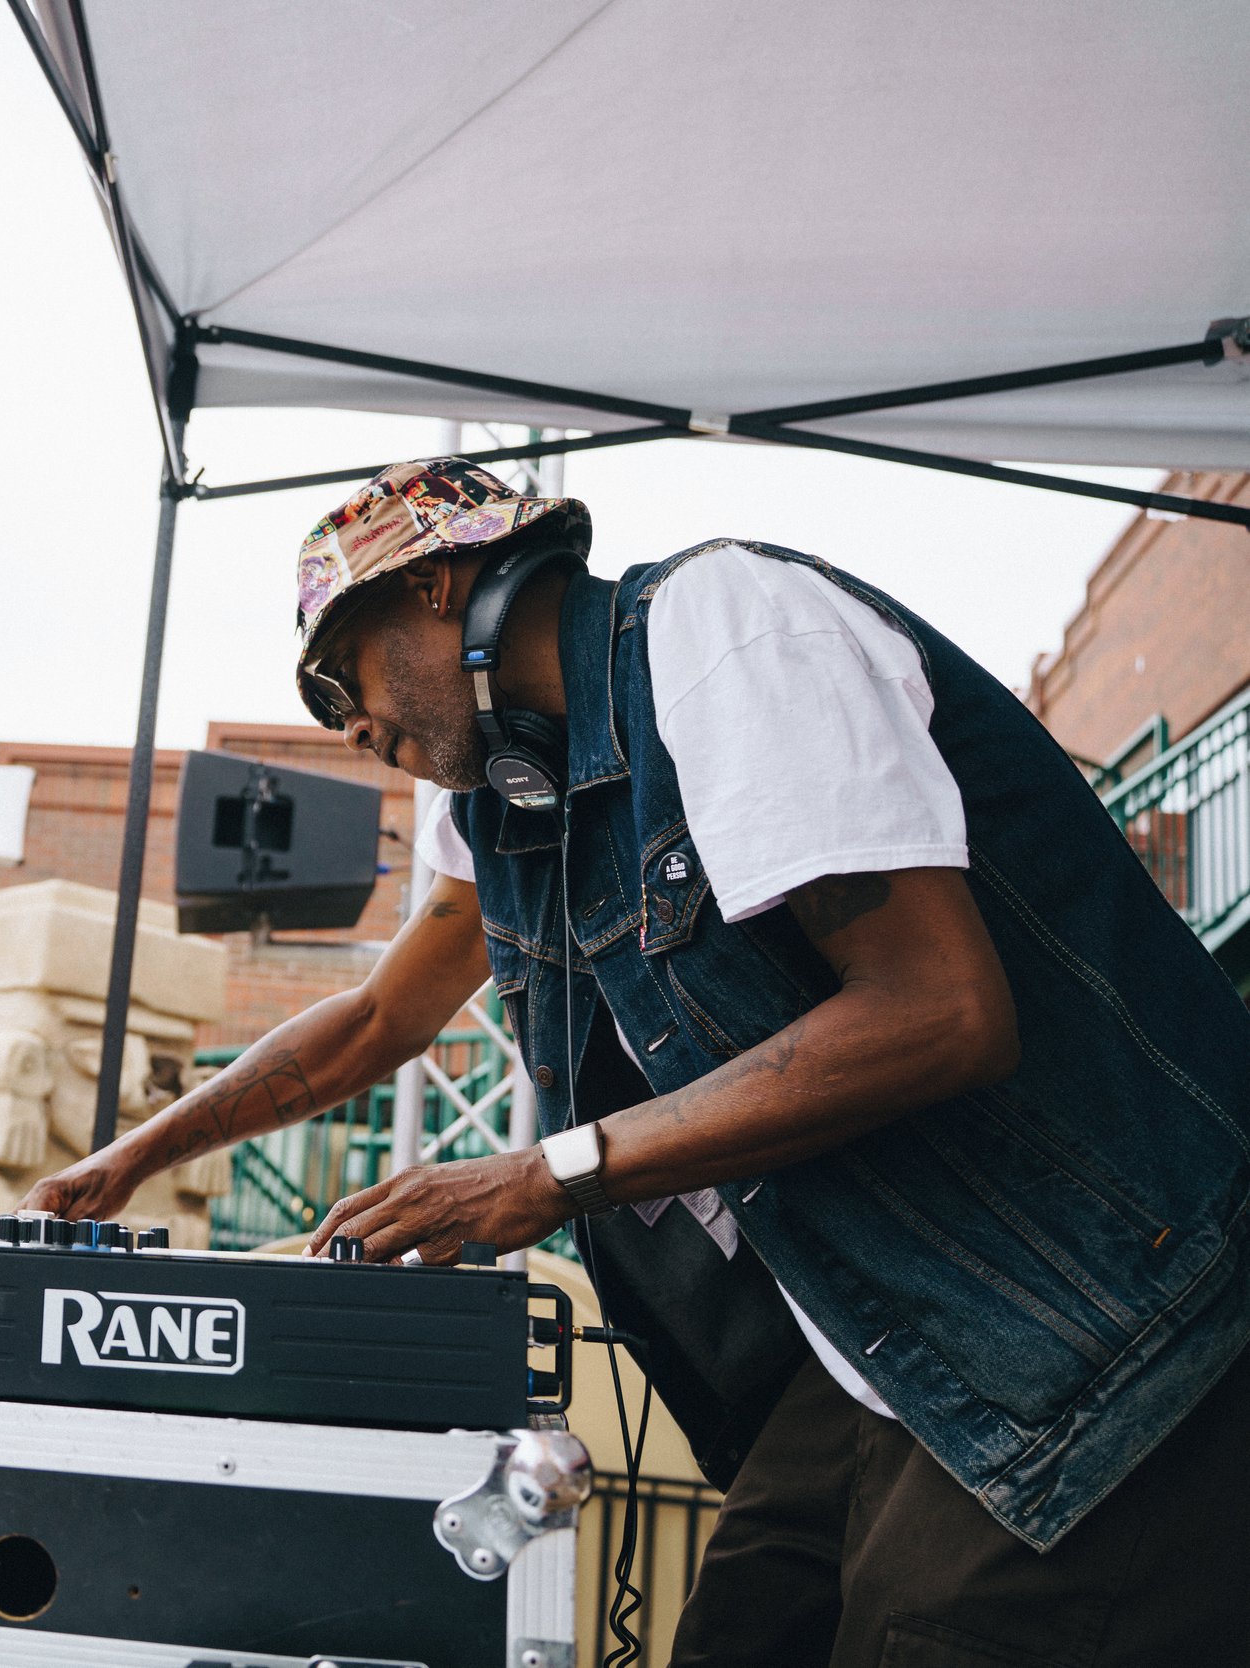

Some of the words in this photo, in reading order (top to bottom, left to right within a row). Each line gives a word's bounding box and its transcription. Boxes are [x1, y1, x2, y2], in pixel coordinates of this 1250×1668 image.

[670, 856, 678, 864] BE
[671, 862, 686, 872] GOOD
[666, 870, 687, 881] PERSON
[41, 1288, 233, 1366] RANE
